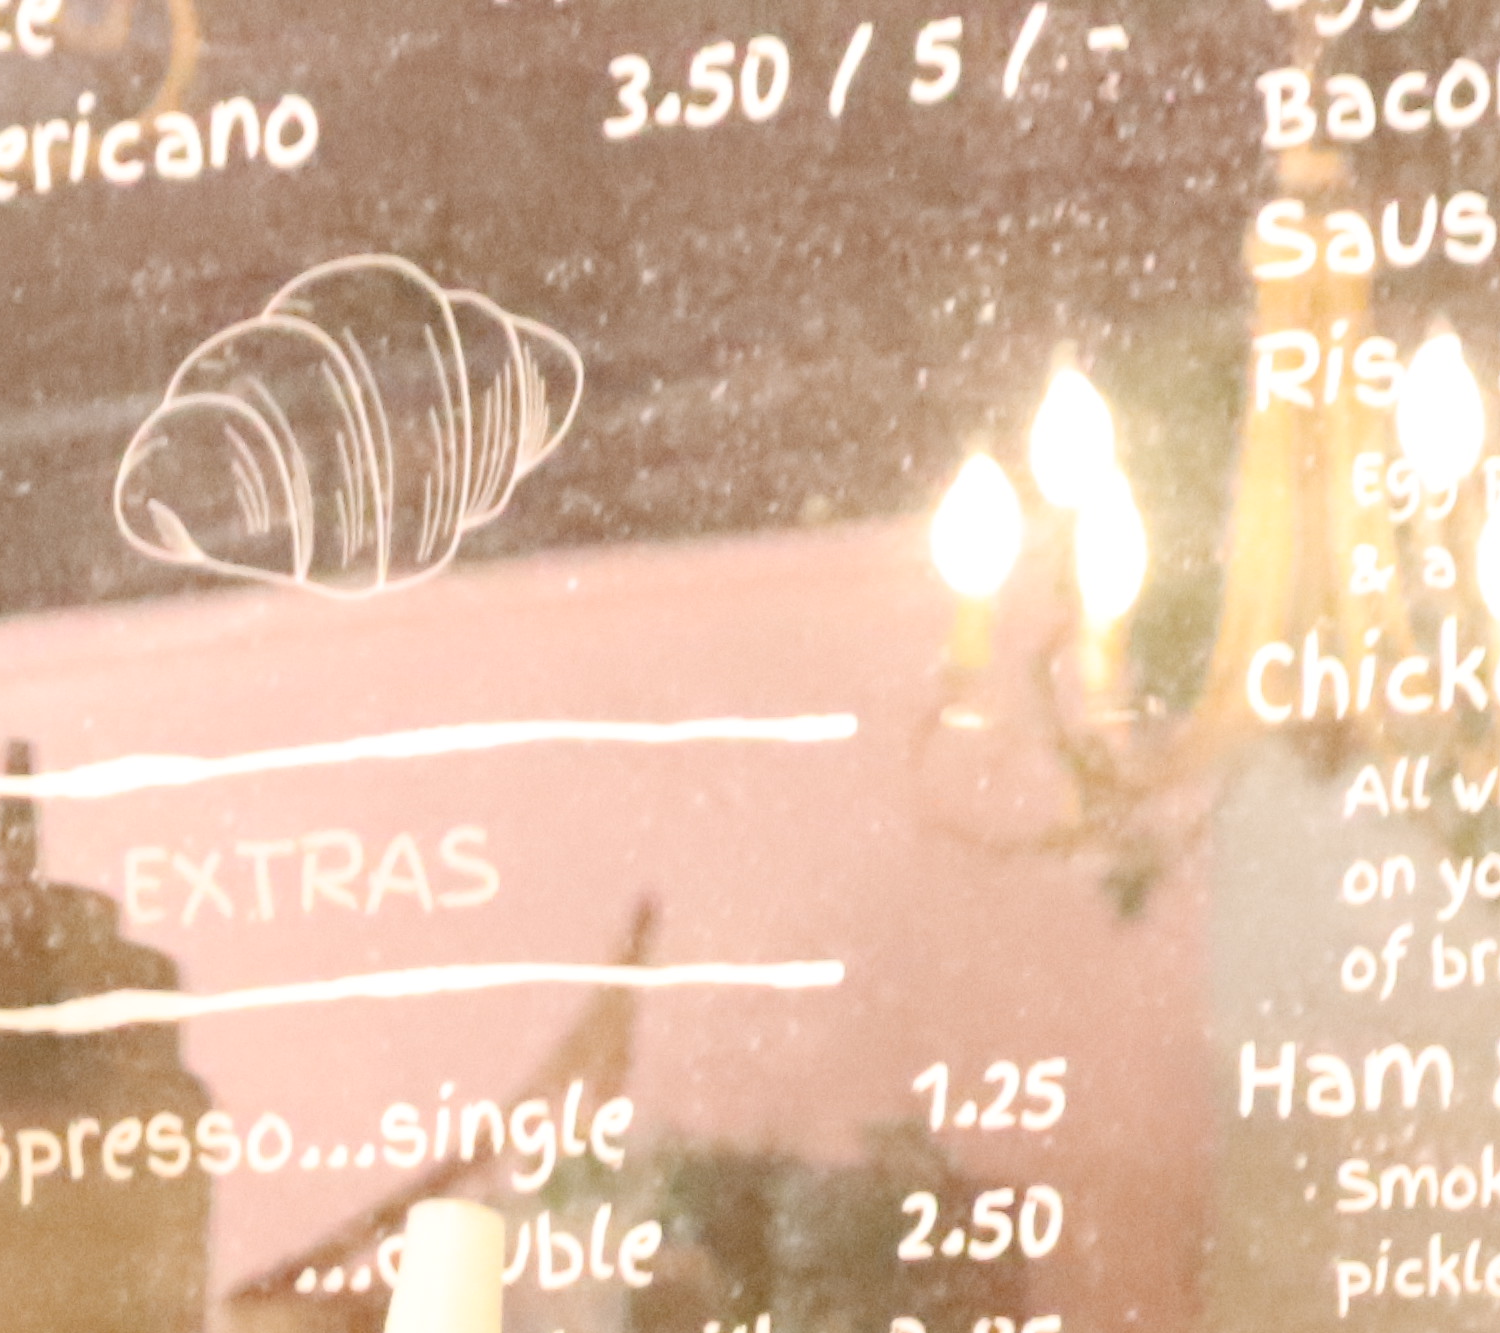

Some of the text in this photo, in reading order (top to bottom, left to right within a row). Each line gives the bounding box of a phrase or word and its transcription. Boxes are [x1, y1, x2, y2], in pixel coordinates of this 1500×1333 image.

[603, 35, 790, 139] 3.50
[829, 22, 873, 118] /
[909, 15, 962, 104] 5
[1003, 2, 1048, 99] /
[1087, 23, 1130, 53] -
[1252, 318, 1450, 412] Ris
[1351, 543, 1396, 595] &
[1422, 545, 1457, 590] a
[1343, 755, 1432, 819] All
[124, 824, 501, 929] EXTRAS
[1340, 853, 1416, 906] on
[1340, 923, 1415, 1001] of
[912, 1057, 1068, 1134] 1.25
[1238, 1041, 1456, 1119] Ham
[898, 1184, 1064, 1263] 2.50
